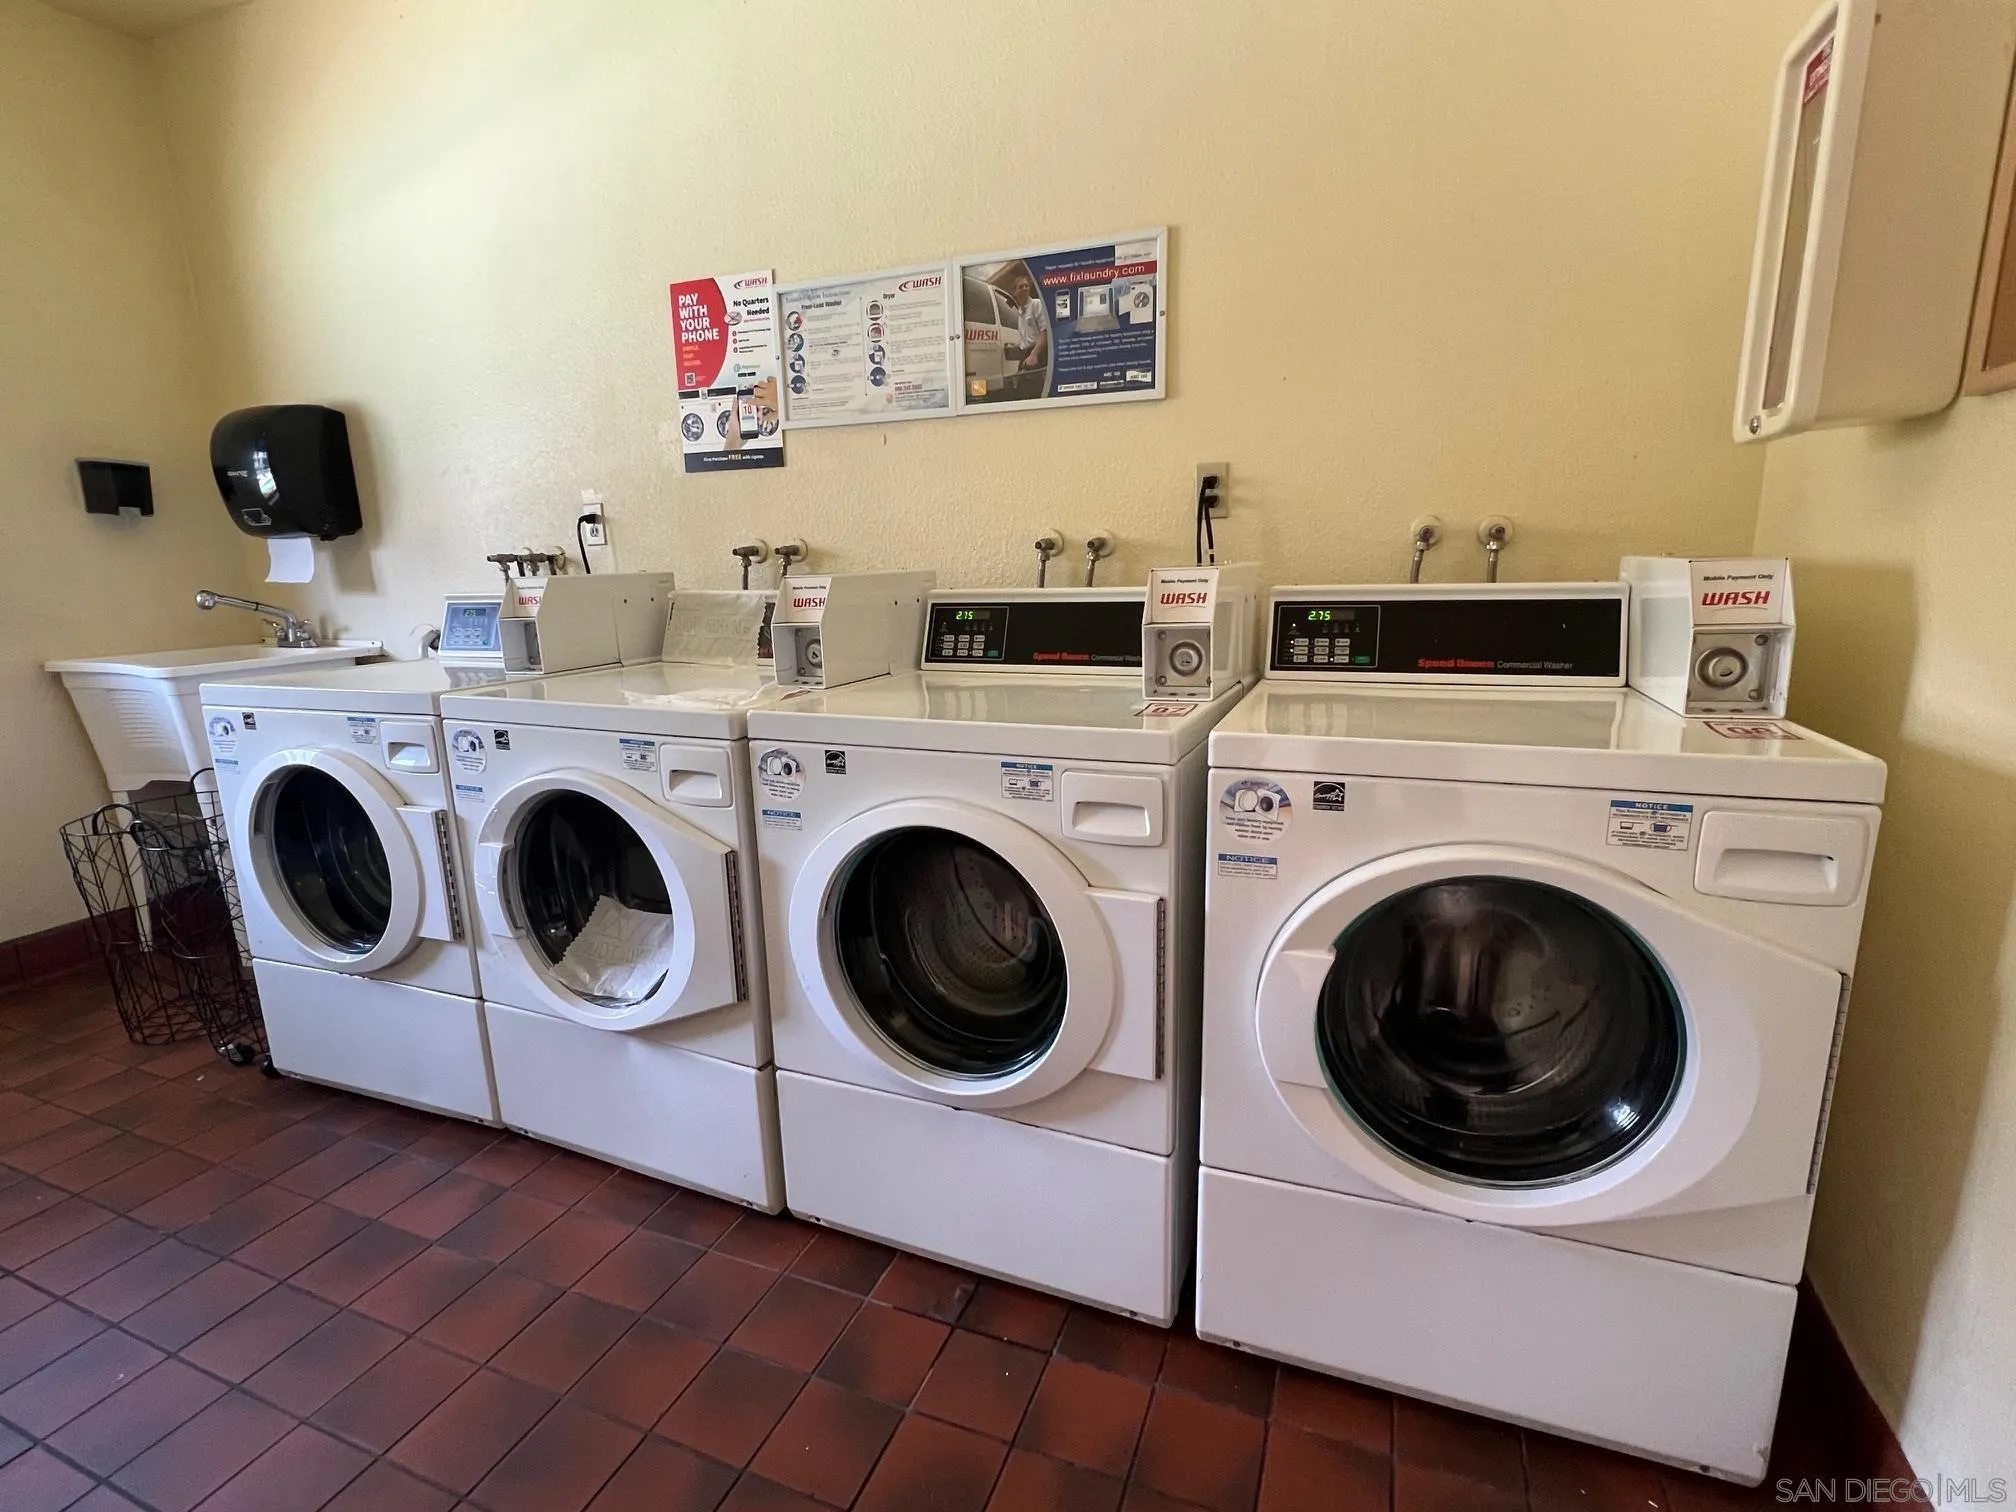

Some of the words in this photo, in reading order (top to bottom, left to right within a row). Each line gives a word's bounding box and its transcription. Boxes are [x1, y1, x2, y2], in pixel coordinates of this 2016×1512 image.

[1042, 265, 1145, 286] www.fixlaundry.com
[745, 277, 768, 287] WASH
[912, 276, 942, 289] WASH
[678, 293, 699, 307] PAY
[742, 297, 769, 307] Quarters
[679, 304, 708, 319] WITH
[746, 307, 770, 316] Needed
[680, 317, 710, 331] YOUR
[681, 328, 720, 343] PHONE
[965, 329, 998, 341] WASH
[793, 597, 826, 608] WASH
[1160, 592, 1208, 605] WASH
[1701, 590, 1771, 606] WASH
[1497, 660, 1543, 669] Commercial
[1544, 662, 1573, 670] Washer
[1634, 802, 1669, 810] NOTICE
[1226, 855, 1269, 863] NOTICE
